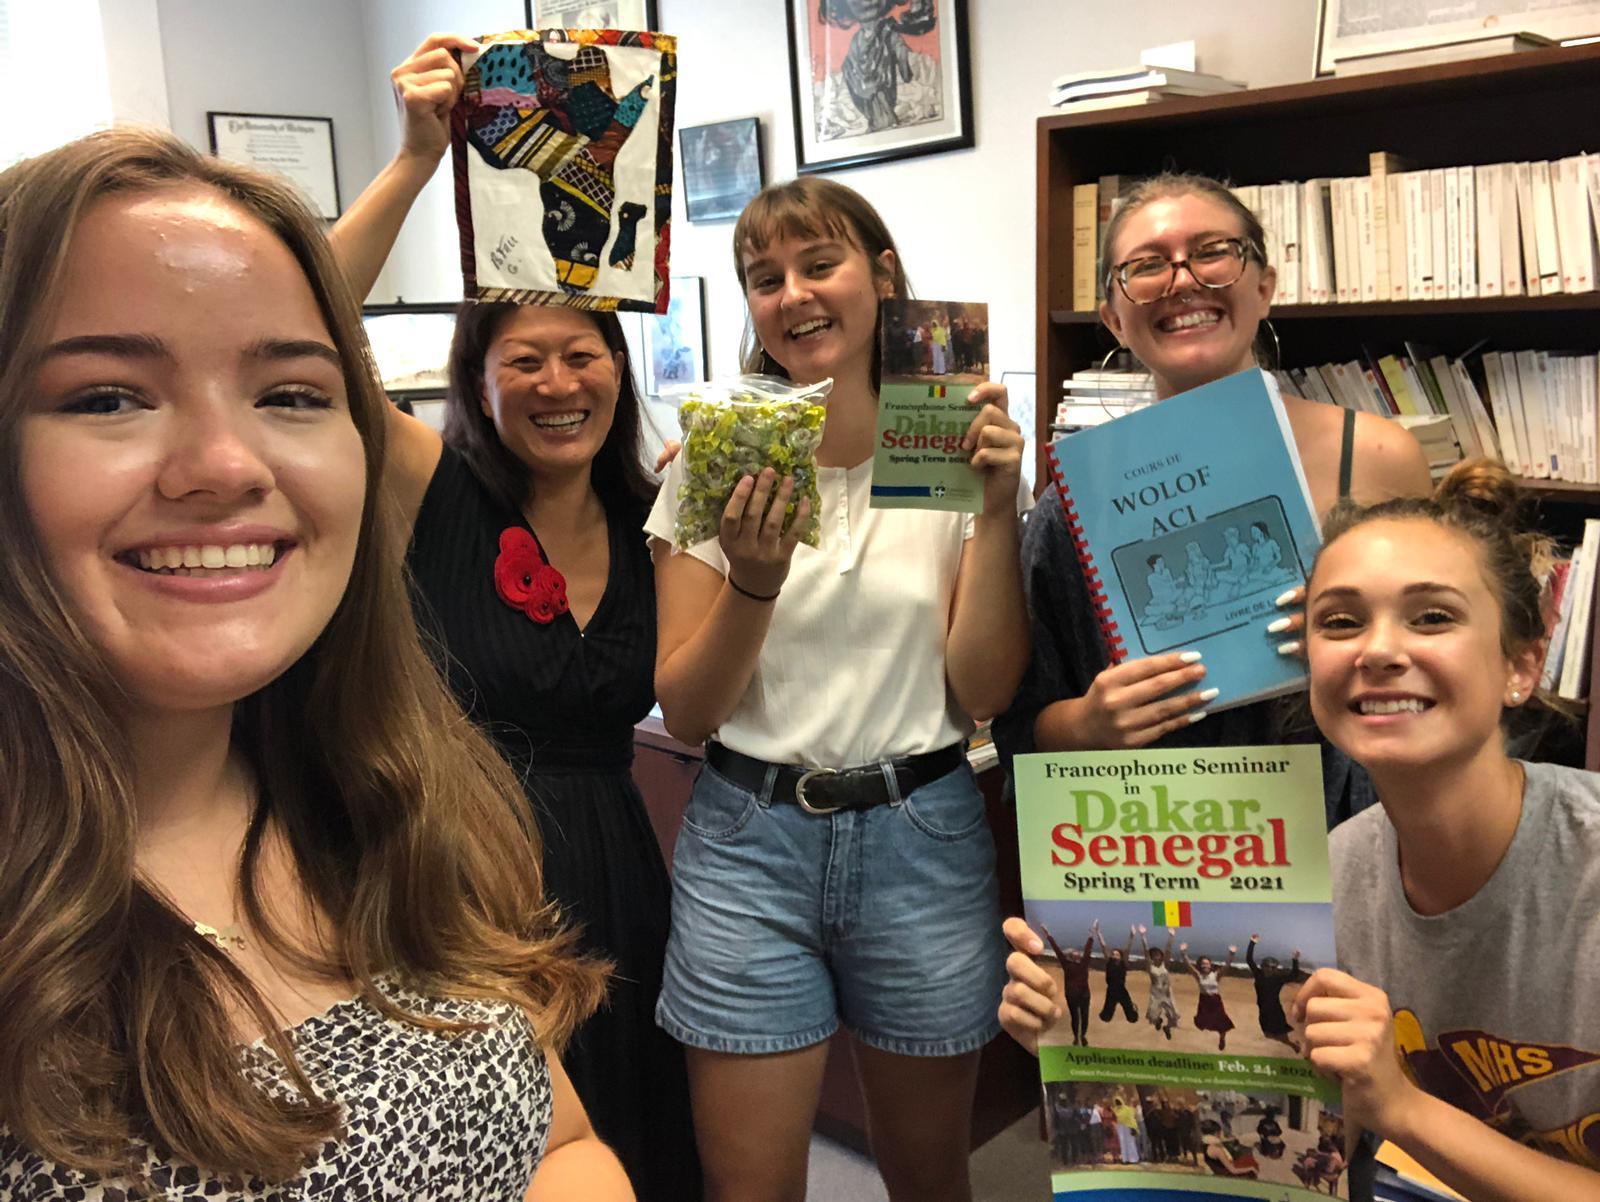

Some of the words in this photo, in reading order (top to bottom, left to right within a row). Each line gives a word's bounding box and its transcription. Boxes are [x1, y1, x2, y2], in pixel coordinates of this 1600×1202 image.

[889, 454, 920, 464] Spring
[921, 454, 946, 463] Term
[1123, 461, 1165, 480] COURS
[1111, 465, 1210, 515] WOLOF
[1151, 504, 1197, 538] ACI
[1044, 759, 1187, 780] Francophone
[1193, 756, 1290, 775] Seminar
[1123, 781, 1140, 795] in
[1069, 784, 1265, 834] Dakar,
[1051, 818, 1292, 880] Senegal
[1064, 872, 1135, 893] Spring
[1139, 872, 1200, 891] Term
[1230, 875, 1284, 891] 2021
[1065, 1051, 1145, 1068] Application
[1147, 1056, 1214, 1072] deadline:
[1218, 1060, 1250, 1074] Feb.
[1252, 1063, 1278, 1077] 24,
[1452, 1038, 1553, 1092] MHS
